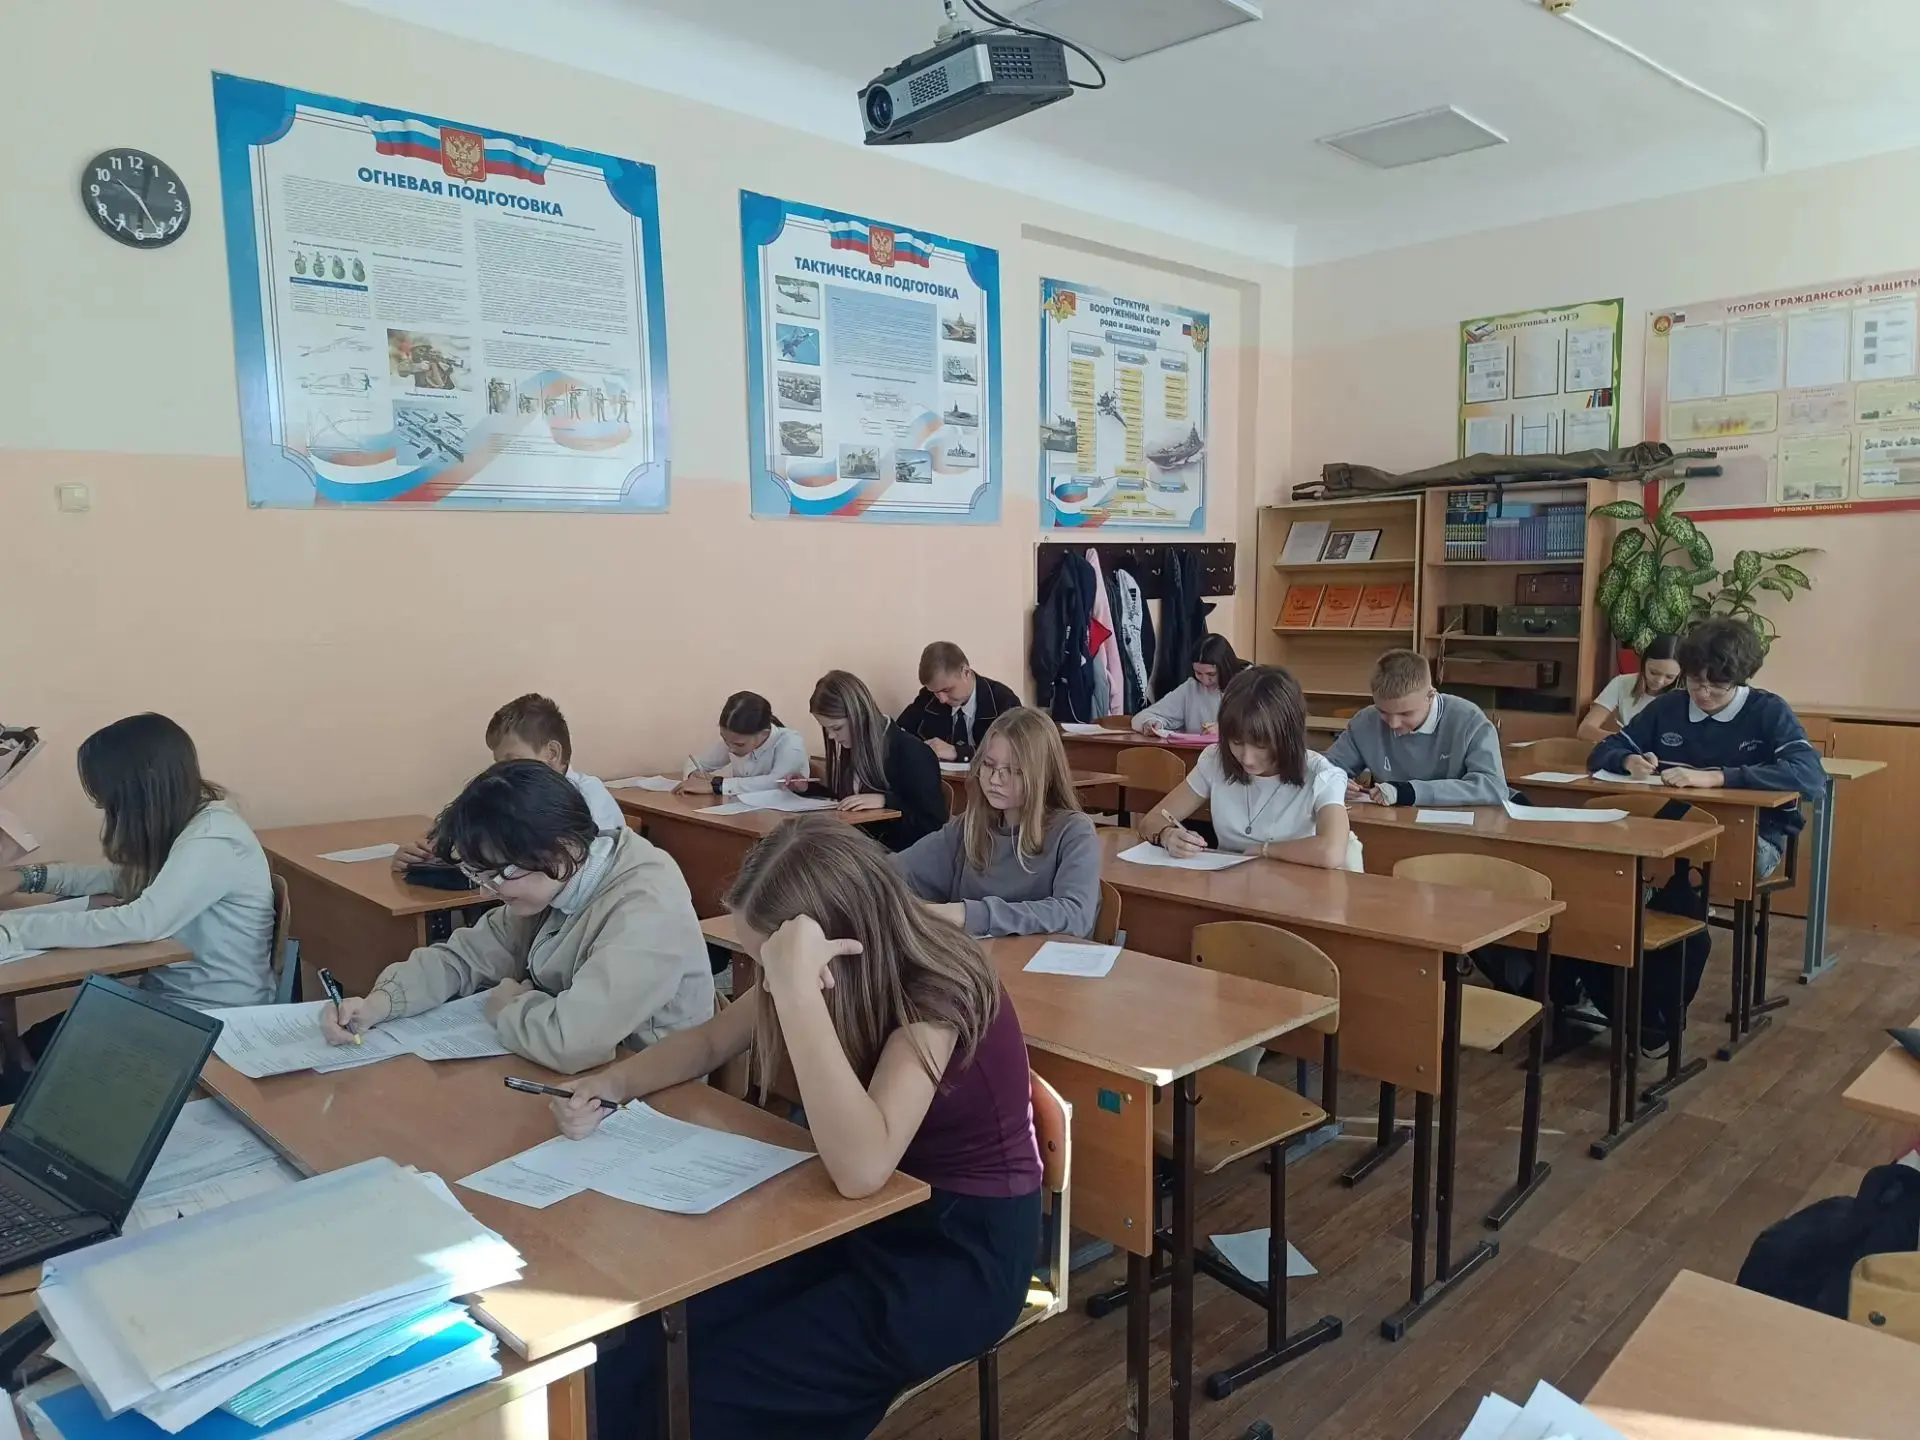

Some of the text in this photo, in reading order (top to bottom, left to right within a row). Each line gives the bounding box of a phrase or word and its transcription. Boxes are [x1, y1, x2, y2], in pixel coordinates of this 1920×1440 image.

[109, 156, 122, 171] 11
[127, 155, 144, 170] 12
[95, 167, 111, 182] 10
[152, 165, 159, 178] 1
[90, 184, 100, 197] 9
[167, 181, 177, 195] 2
[357, 167, 564, 217] ОГНЕВАЯ ПОДГОТОВКА
[98, 203, 107, 216] 8
[174, 200, 183, 212] 3
[115, 218, 126, 231] 7
[168, 216, 178, 229] 4
[135, 228, 144, 240] 6
[794, 256, 959, 300] ТАКТИЧЕСКАЯ ПОДГОТОВКА
[1726, 300, 1771, 314] УГОЛОК
[1774, 285, 1863, 307] ГРАЖДАНСКОЙ
[1867, 278, 1920, 293] ЗАЩИТЫ
[1113, 297, 1150, 313] СТРУКТУРА
[1089, 303, 1171, 327] ВООРУЖЕННЫХ СИЛ РФ
[1495, 318, 1549, 331] Подготовка
[1559, 312, 1579, 323] ОГЭ
[1124, 323, 1142, 332] виды
[1142, 326, 1161, 336] войск
